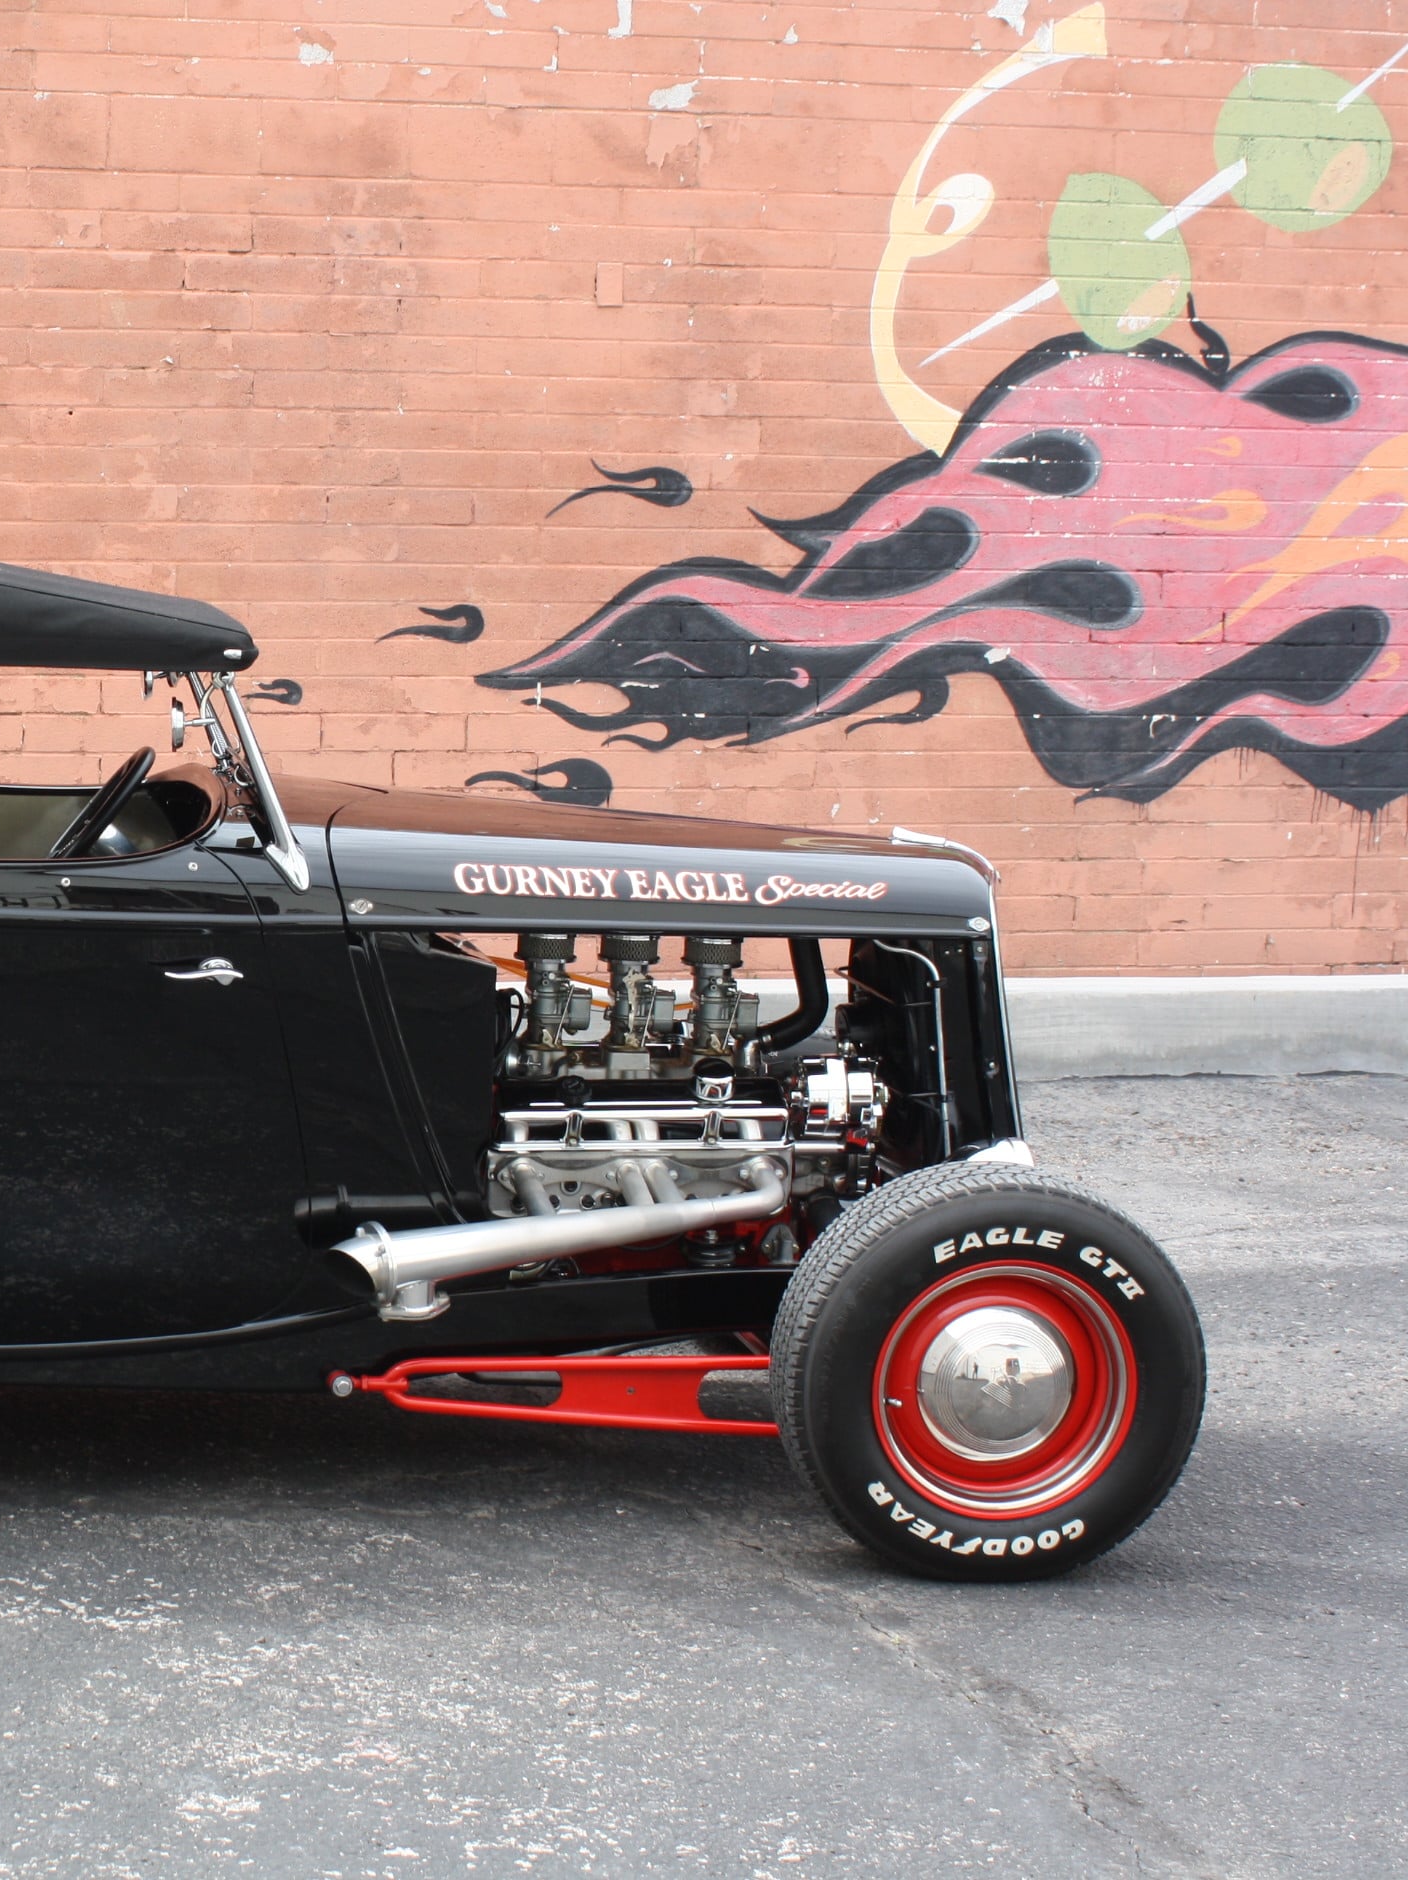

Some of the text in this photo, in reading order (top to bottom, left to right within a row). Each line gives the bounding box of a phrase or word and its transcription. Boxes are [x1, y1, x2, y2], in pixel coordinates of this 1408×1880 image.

[453, 862, 888, 905] GURNEY EAGLE Special
[933, 1227, 1066, 1264] EAGLE
[867, 1480, 1085, 1556] GOODYEAR
